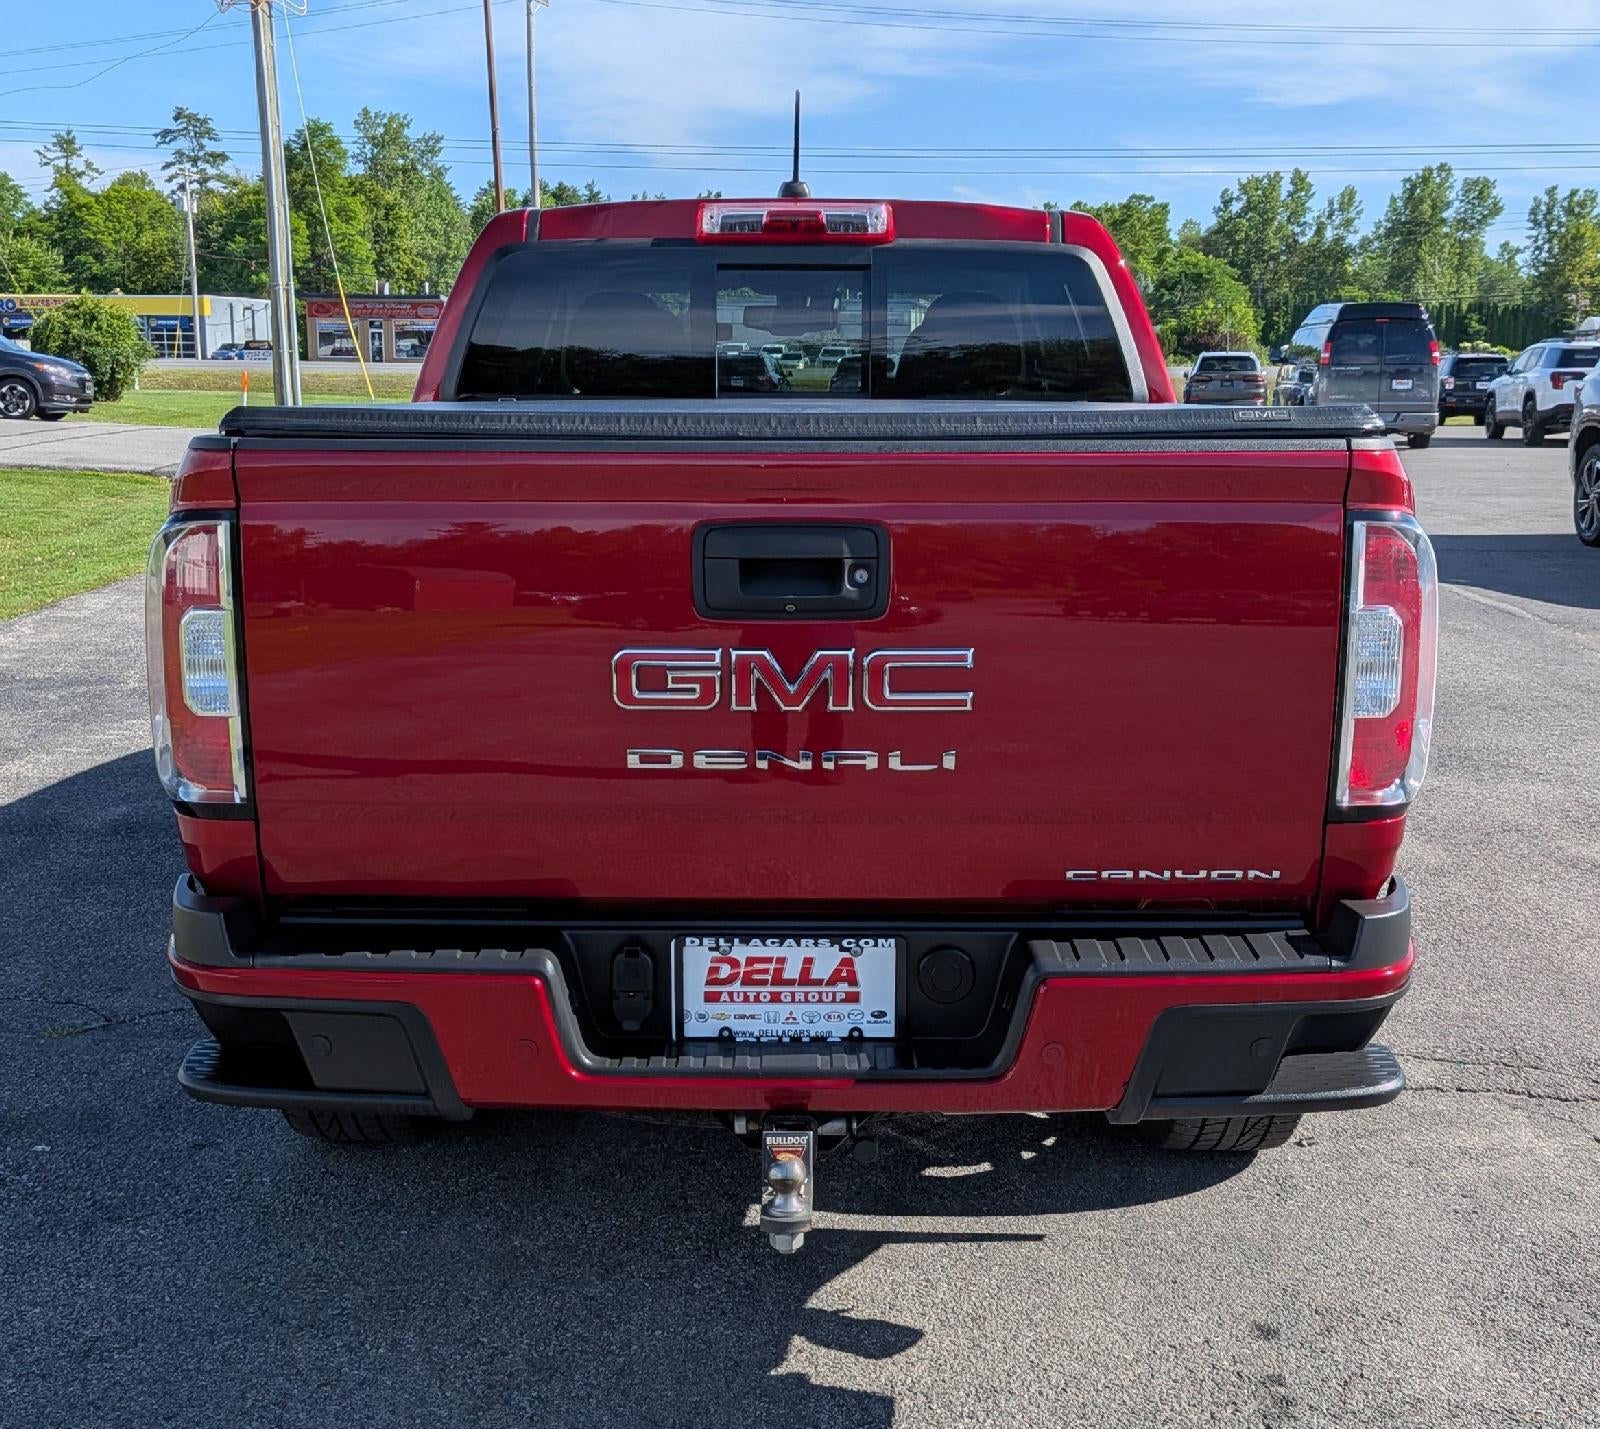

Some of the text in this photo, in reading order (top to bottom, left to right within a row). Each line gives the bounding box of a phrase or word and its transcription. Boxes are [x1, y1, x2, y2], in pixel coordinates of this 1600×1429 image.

[1239, 410, 1288, 418] GMC
[611, 647, 974, 711] GMC
[626, 749, 956, 770] DENALI
[1065, 869, 1281, 880] CANYON
[685, 937, 895, 948] DELLACARS.COM
[704, 956, 861, 988] DELLA
[719, 992, 846, 1003] AUTO GROUP
[766, 1136, 807, 1145] BULLDOG
